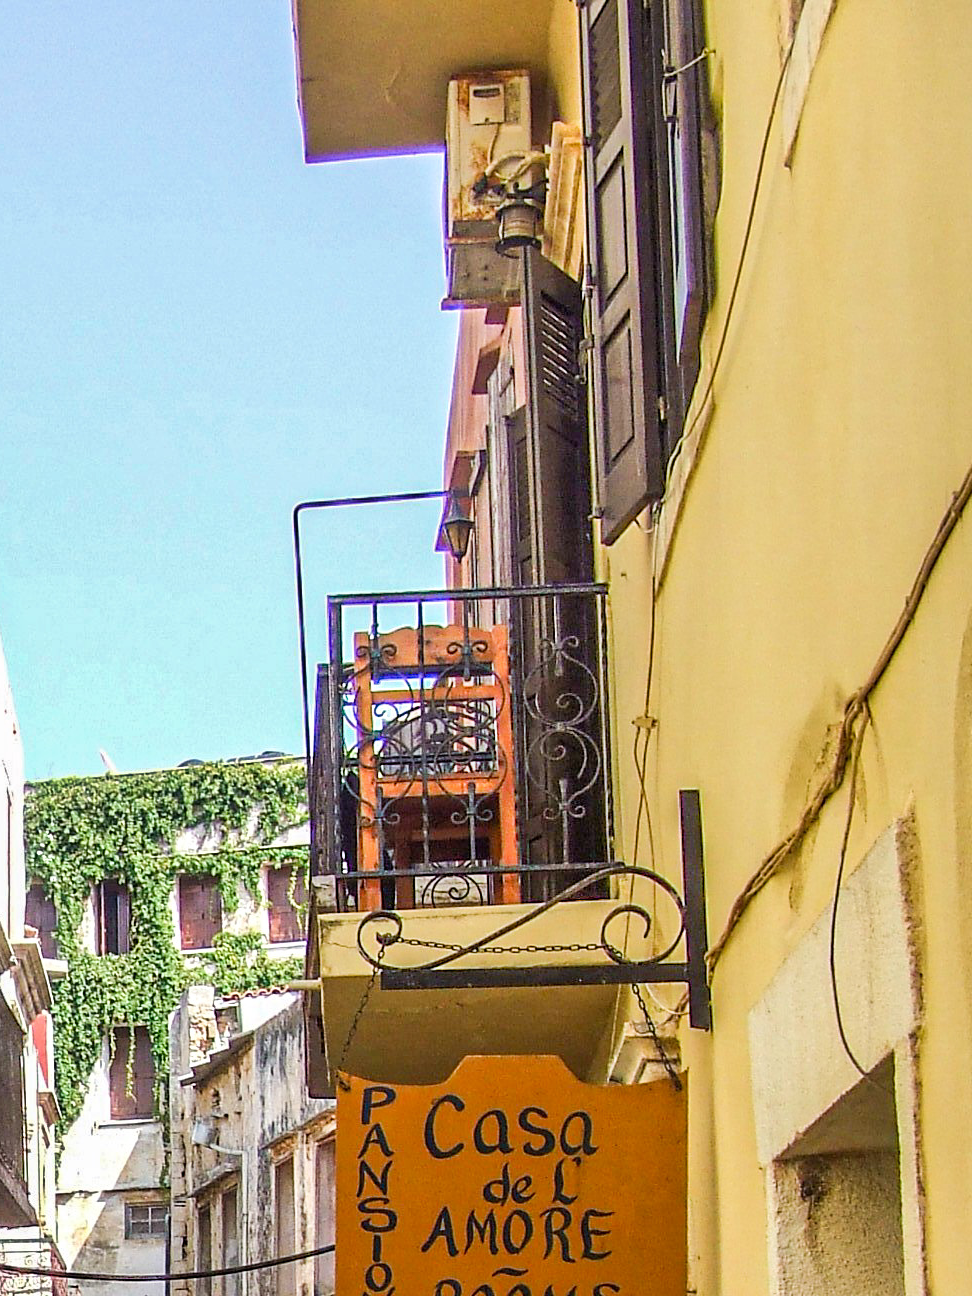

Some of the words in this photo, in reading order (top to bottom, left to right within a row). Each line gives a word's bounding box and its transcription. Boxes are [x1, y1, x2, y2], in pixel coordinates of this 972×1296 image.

[423, 1094, 600, 1160] Casa
[482, 1162, 536, 1206] de
[420, 1206, 617, 1264] AMORE
